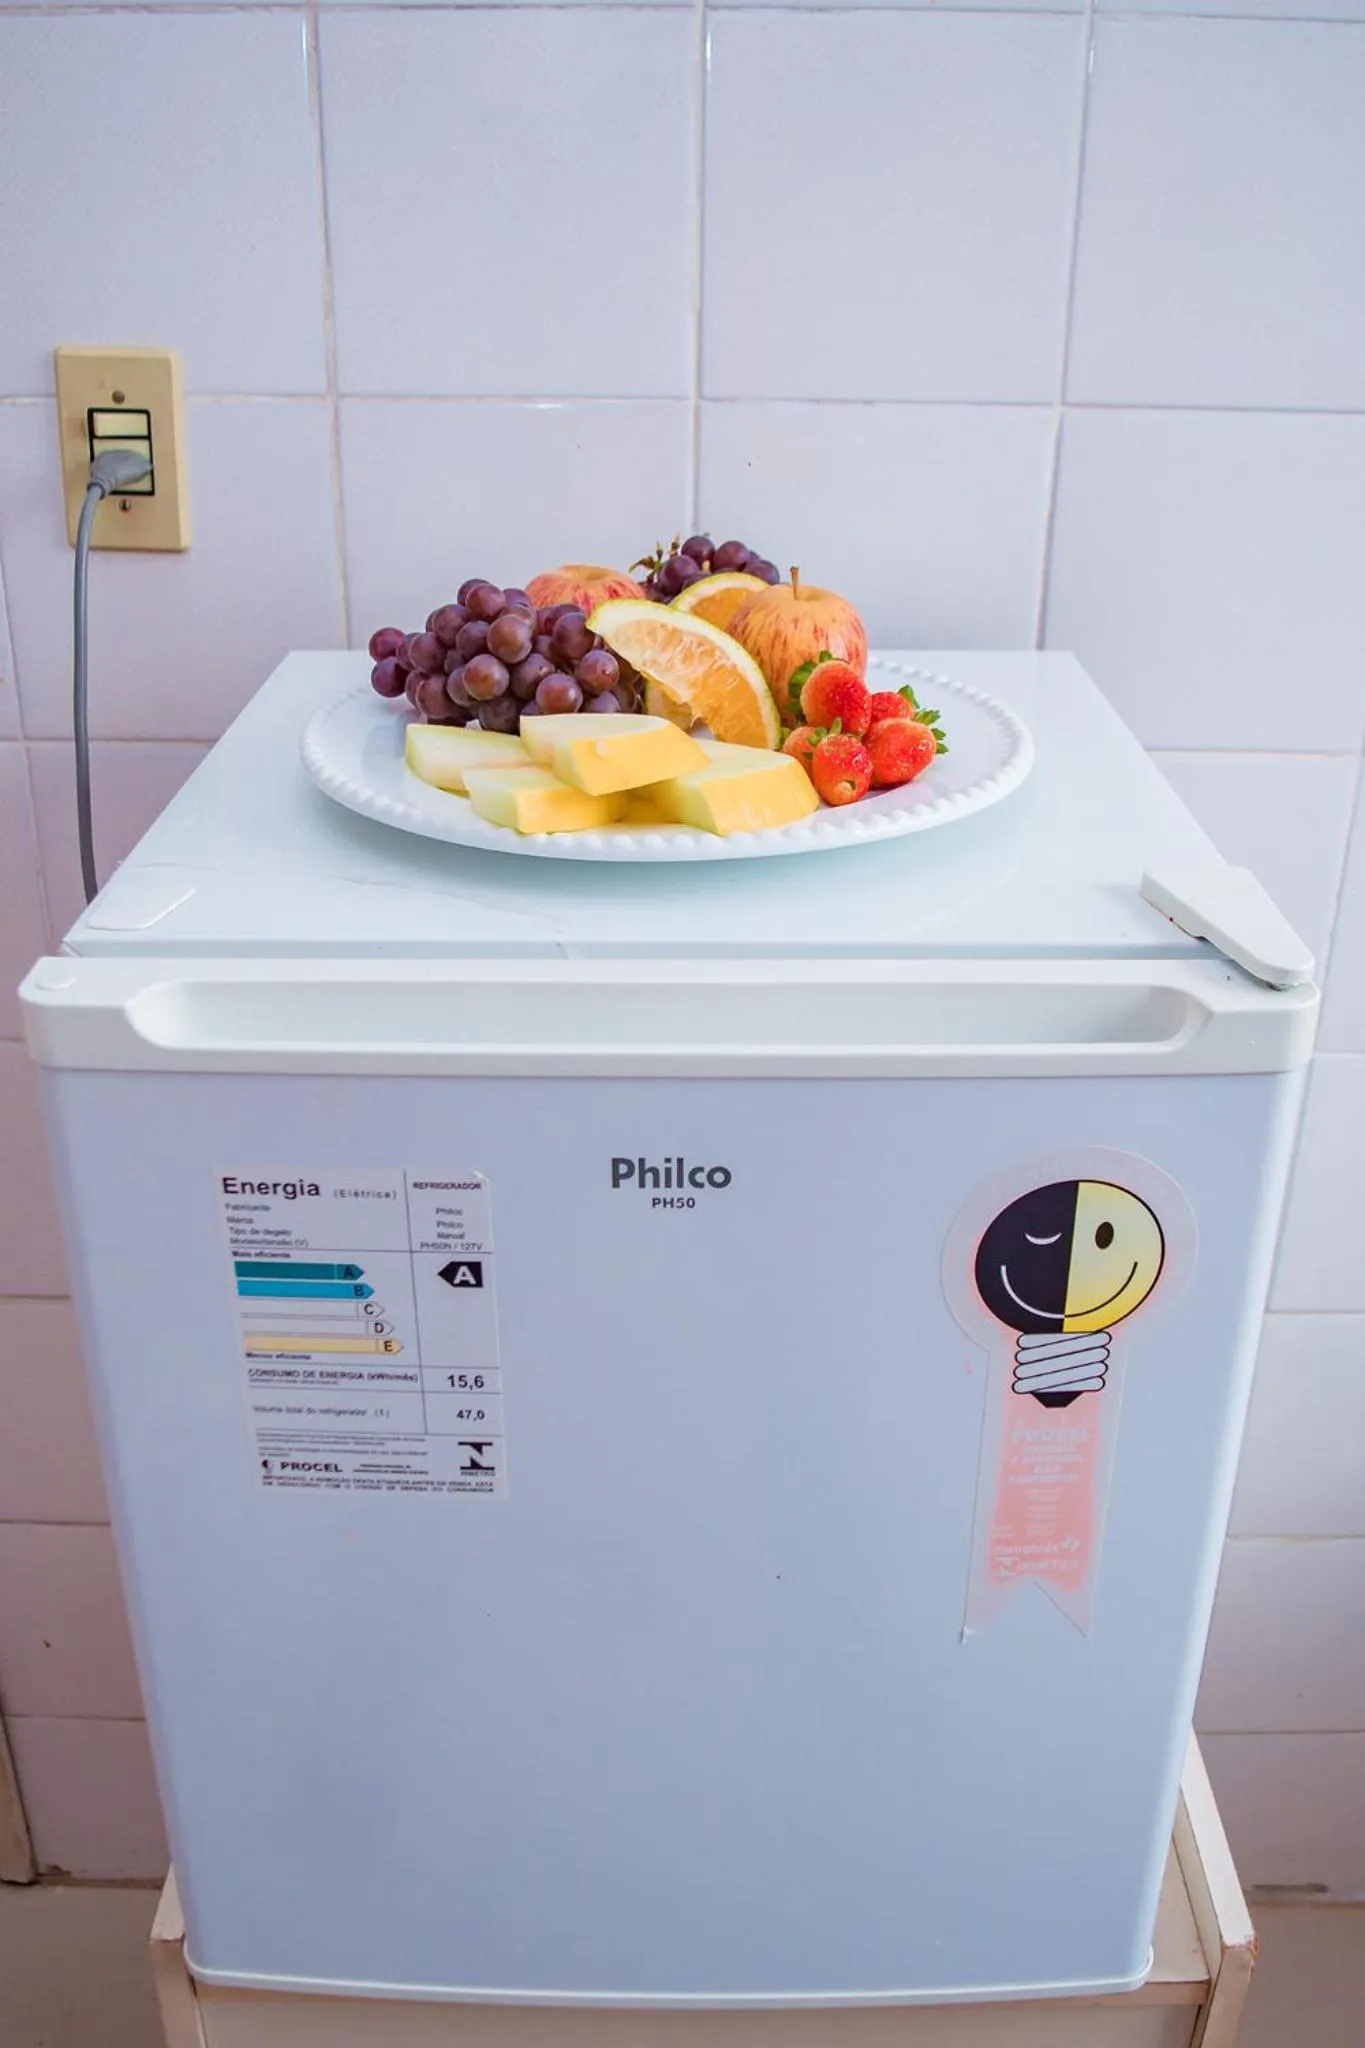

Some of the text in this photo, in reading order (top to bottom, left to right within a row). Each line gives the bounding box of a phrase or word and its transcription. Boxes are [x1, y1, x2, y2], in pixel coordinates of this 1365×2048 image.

[612, 1157, 732, 1189] Philco
[222, 1176, 321, 1200] Energia
[651, 1197, 696, 1209] PH50
[343, 1266, 355, 1279] A
[453, 1265, 477, 1285] A
[354, 1285, 364, 1297] B
[364, 1304, 374, 1316] C
[374, 1323, 384, 1334] D
[383, 1340, 393, 1352] E
[248, 1368, 301, 1379] CONSUMO
[302, 1370, 316, 1379] DE
[318, 1371, 364, 1381] ENERGIA
[446, 1374, 485, 1390] 15,6
[456, 1409, 486, 1422] 47,0
[279, 1460, 343, 1473] PROCEL
